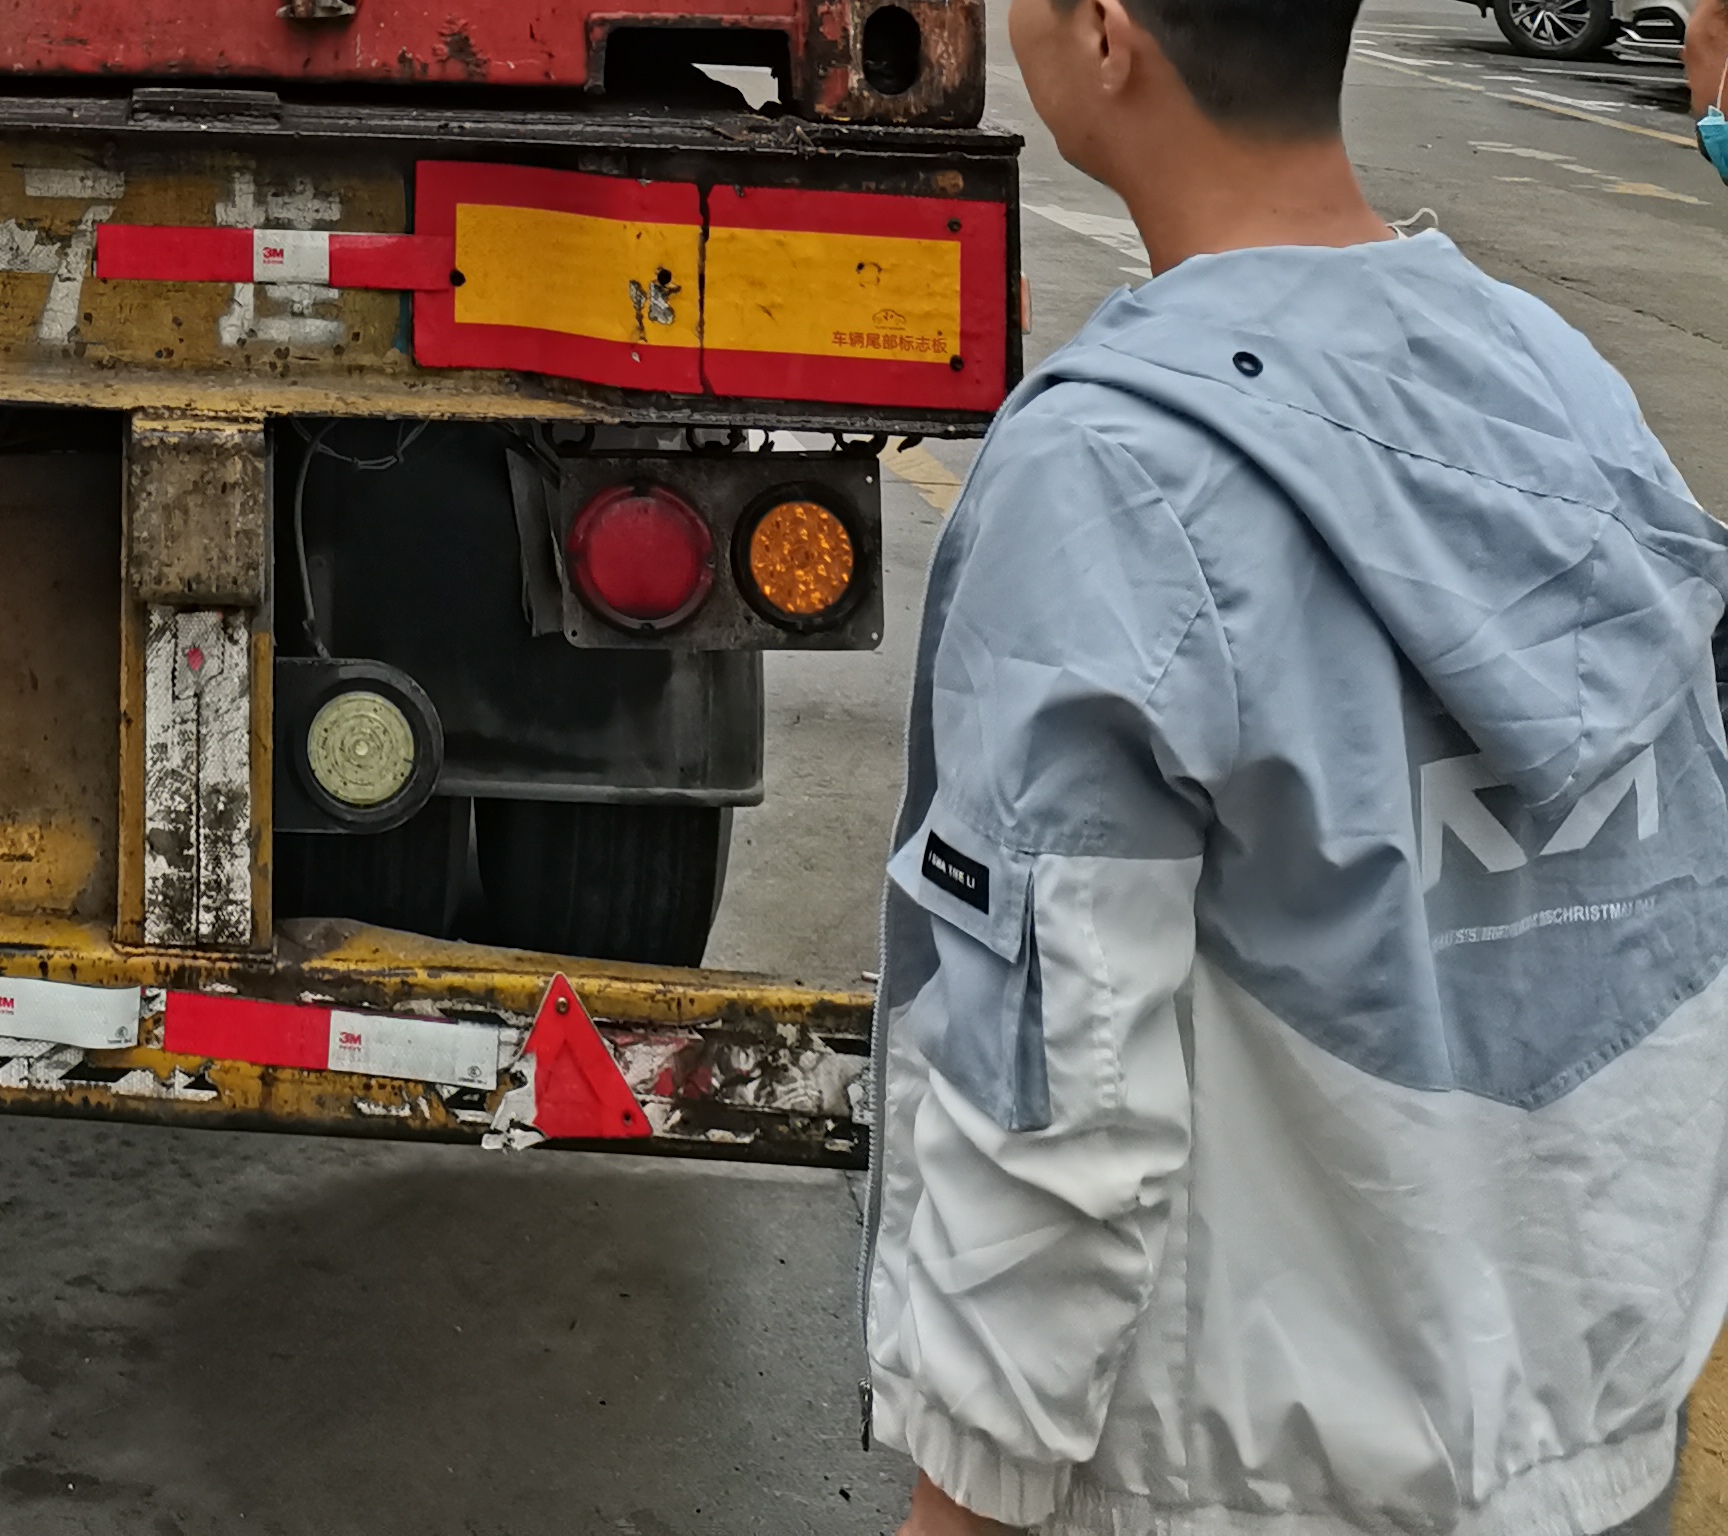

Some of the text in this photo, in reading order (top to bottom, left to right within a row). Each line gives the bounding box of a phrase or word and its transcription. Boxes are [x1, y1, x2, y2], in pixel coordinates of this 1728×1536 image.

[263, 247, 284, 258] 3M
[832, 330, 948, 354] 车辆尾部标志板
[339, 1031, 361, 1046] 3M
